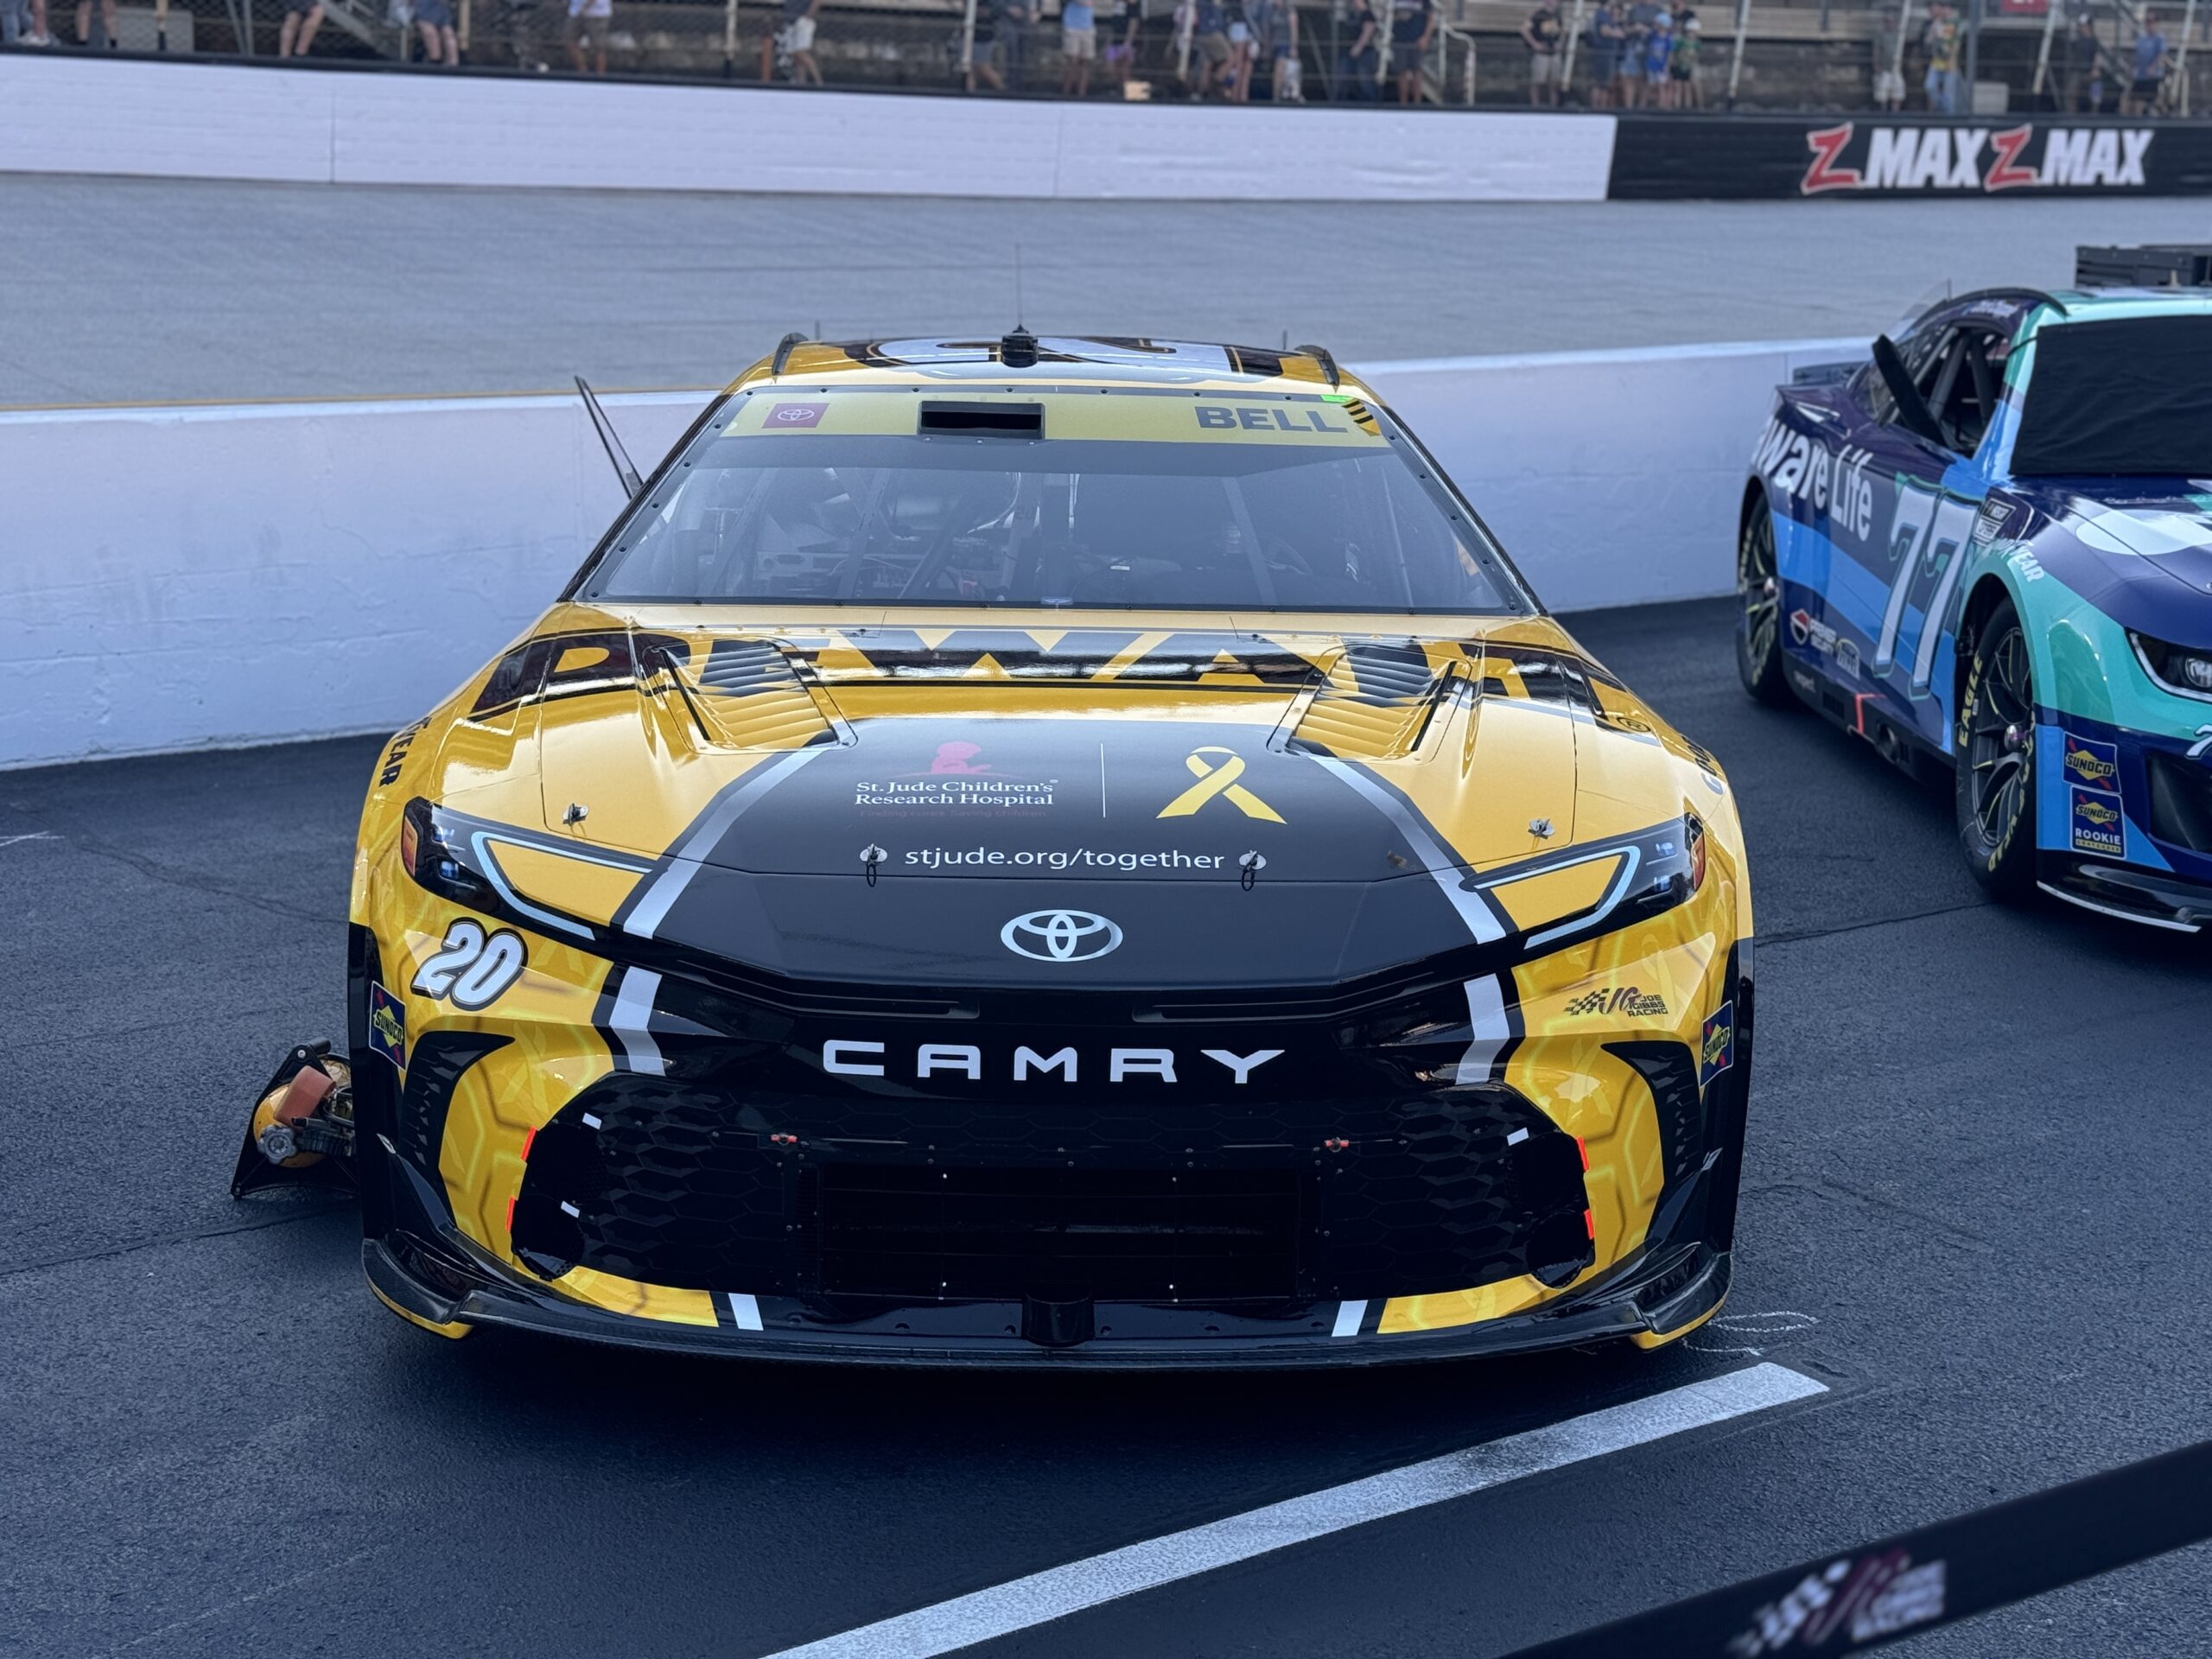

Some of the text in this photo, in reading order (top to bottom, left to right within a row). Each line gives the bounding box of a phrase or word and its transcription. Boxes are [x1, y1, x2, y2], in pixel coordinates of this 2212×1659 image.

[1195, 406, 1348, 433] BELL
[1830, 444, 1873, 542] Life
[1873, 478, 1984, 687] 77
[1958, 656, 1983, 747] EAGLE
[2066, 754, 2113, 775] SUNOCO
[856, 781, 1053, 793] St. Jude Children's
[855, 793, 1053, 807] Research Hospital
[2077, 805, 2116, 821] SUNOCO
[2075, 828, 2120, 845] ROOKIE
[905, 847, 1225, 871] stjude.org/together
[410, 917, 528, 1011] 20
[1627, 1008, 1669, 1018] RACING
[1630, 1001, 1665, 1010] GIBBS
[377, 1011, 403, 1044] SUNOCO
[823, 1039, 1285, 1084] CAMRY
